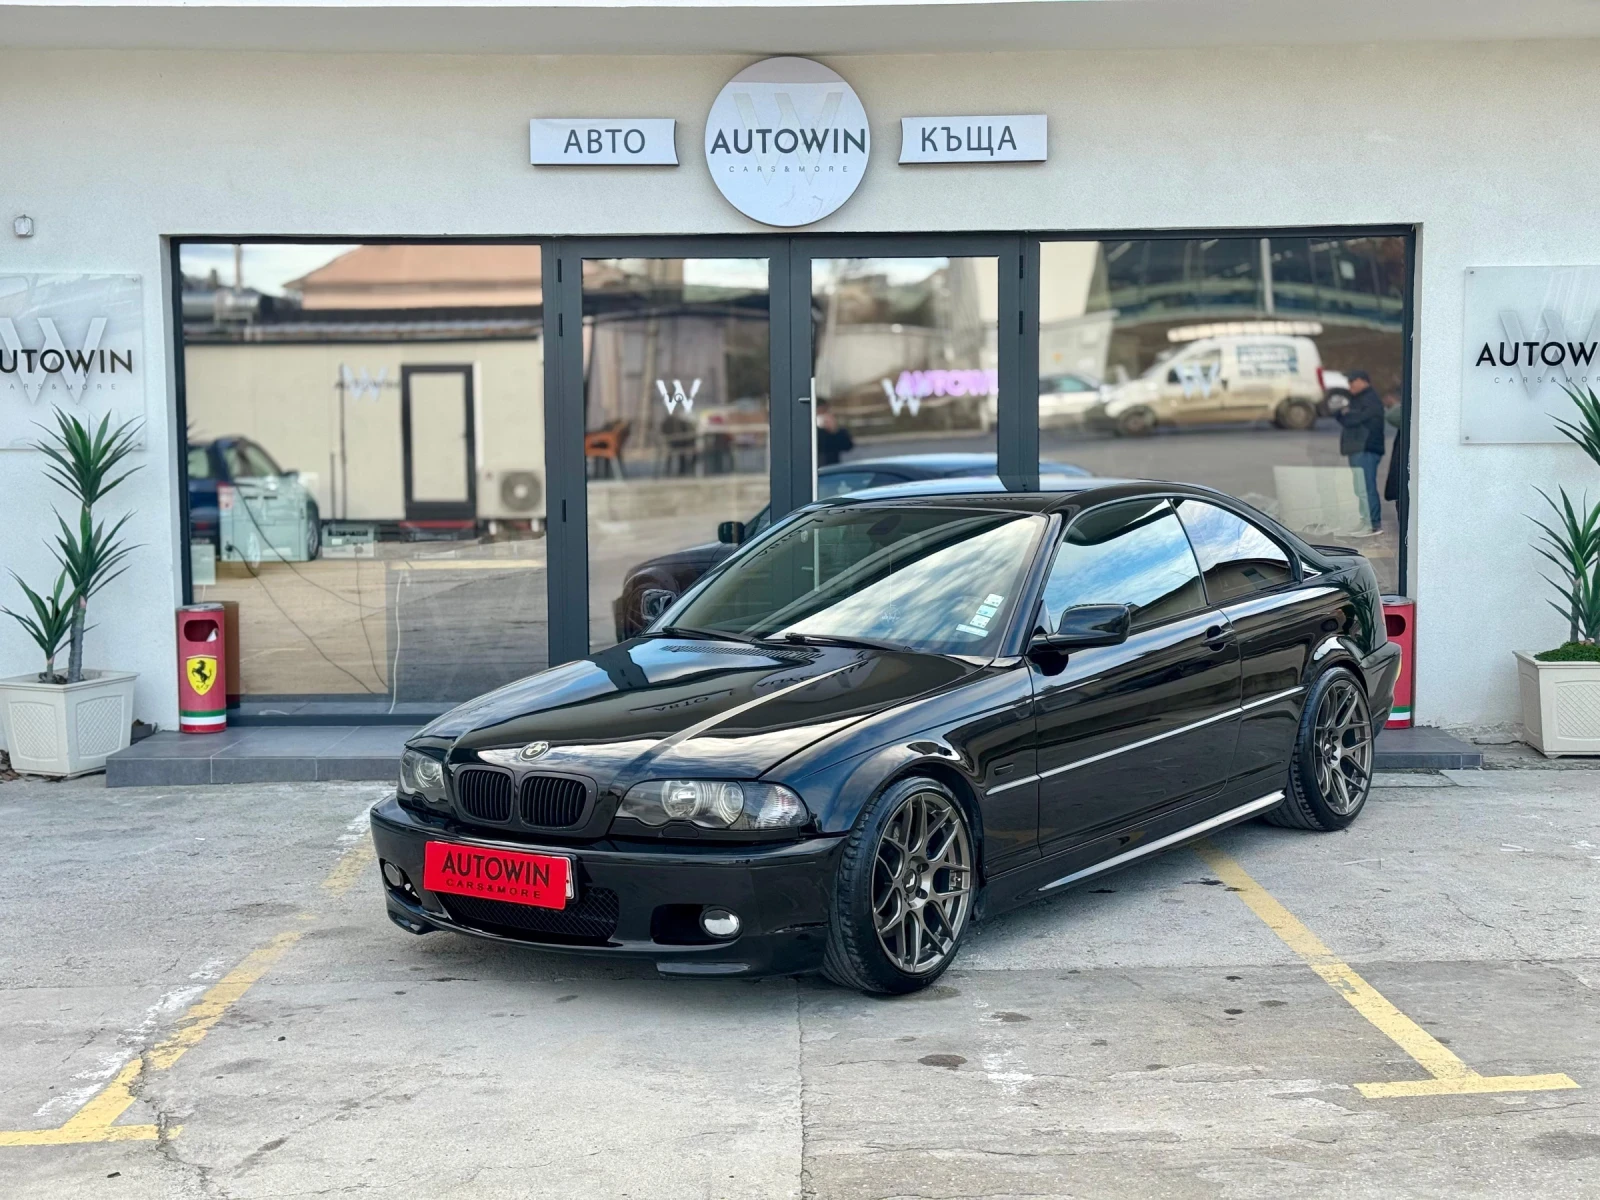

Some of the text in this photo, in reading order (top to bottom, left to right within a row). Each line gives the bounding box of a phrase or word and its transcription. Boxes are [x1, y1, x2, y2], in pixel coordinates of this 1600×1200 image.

[563, 128, 646, 154] АВТО
[710, 128, 865, 154] AUTOWIN
[921, 125, 1017, 156] КЪЩА
[728, 165, 848, 173] CARS&MORE
[1475, 341, 1599, 367] AUTOW
[441, 850, 550, 889] AUTOWIN
[446, 878, 541, 899] CARS&MORE
